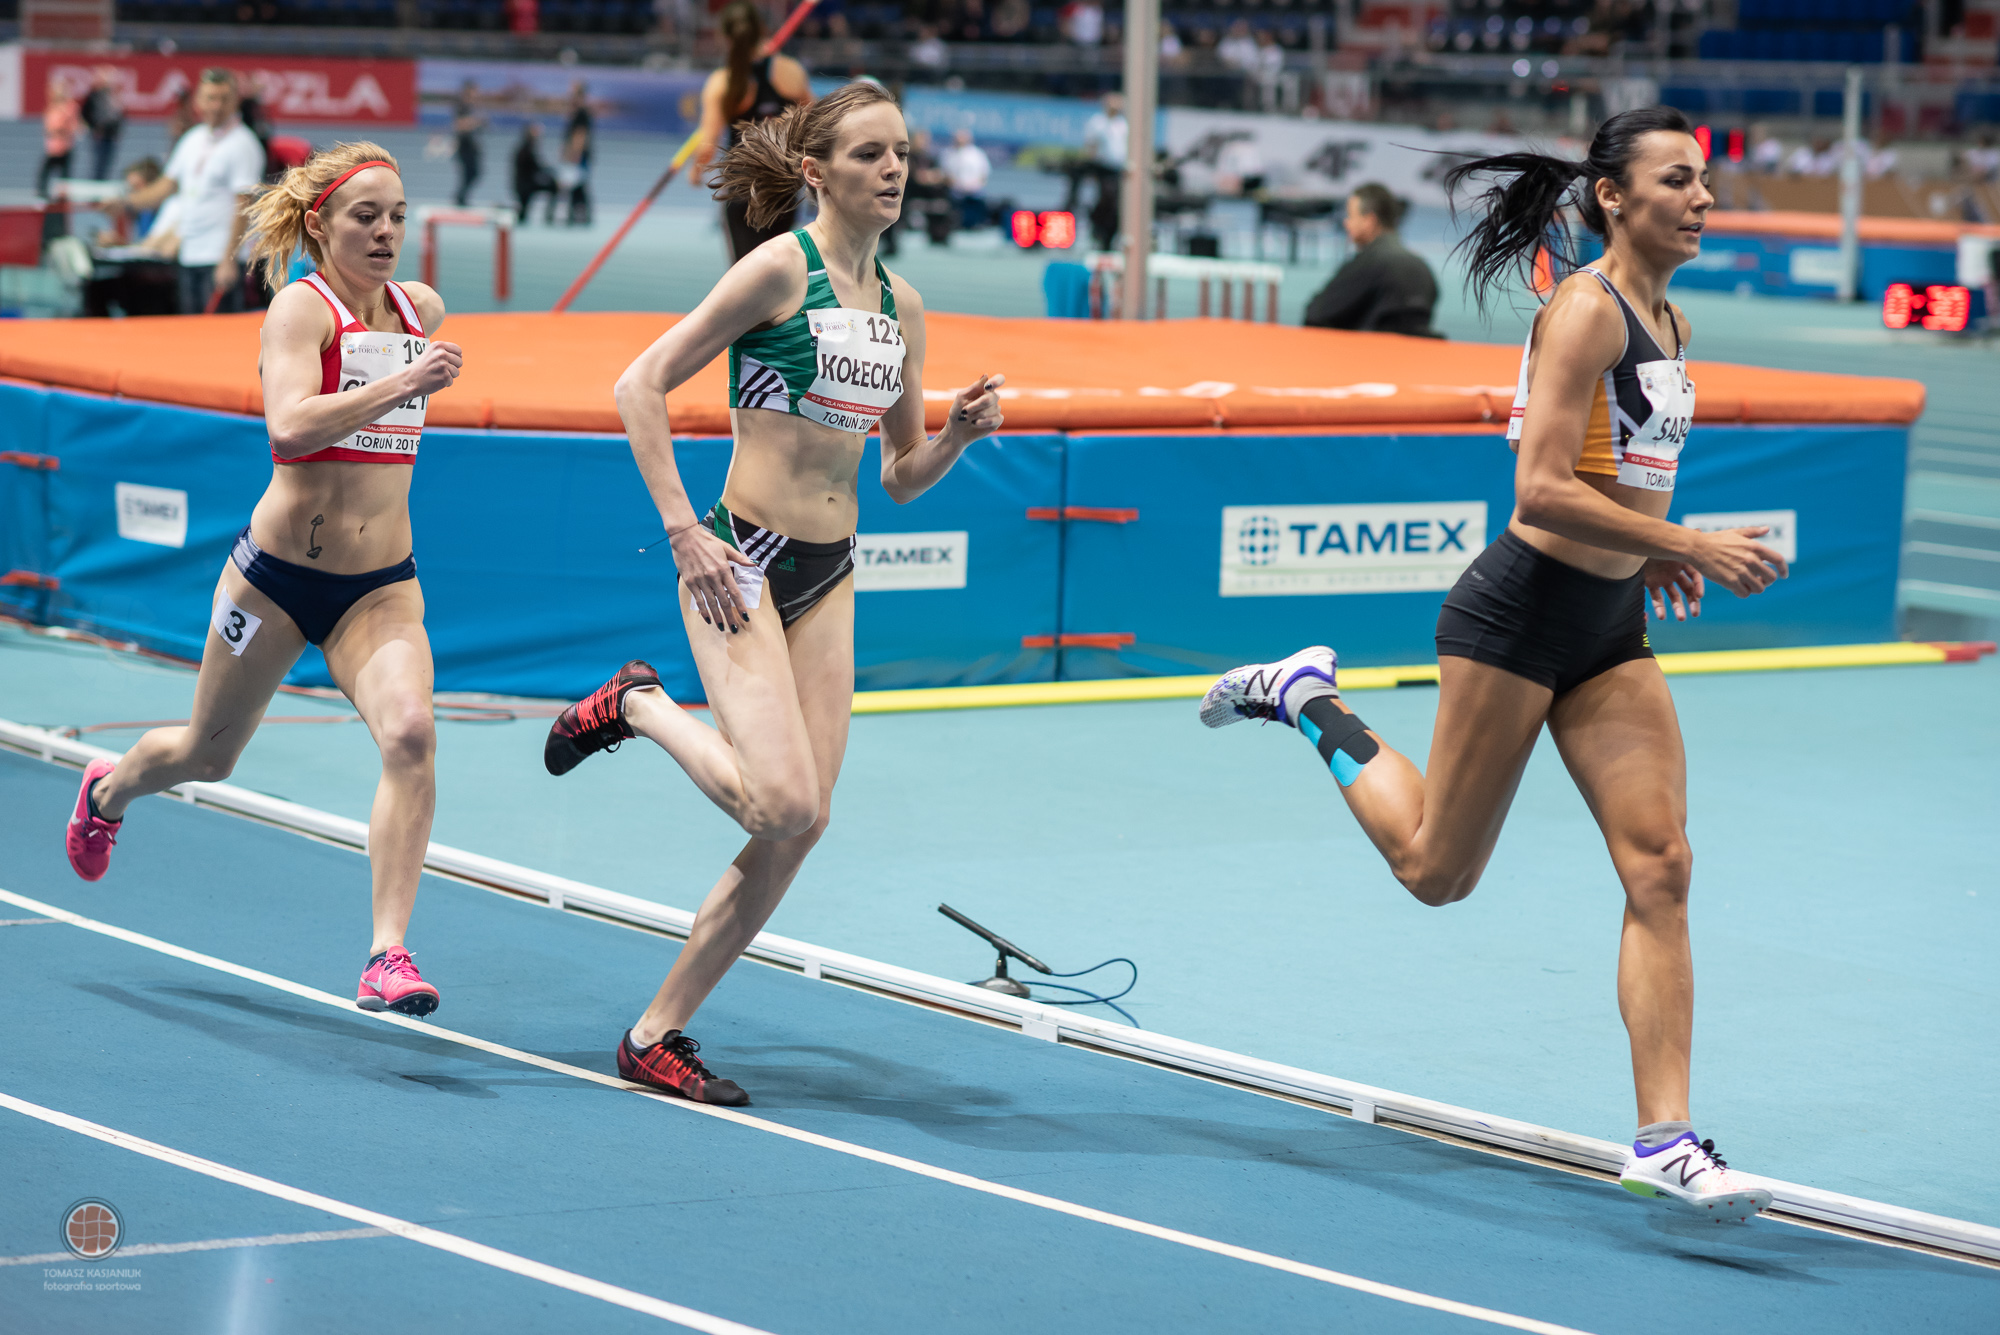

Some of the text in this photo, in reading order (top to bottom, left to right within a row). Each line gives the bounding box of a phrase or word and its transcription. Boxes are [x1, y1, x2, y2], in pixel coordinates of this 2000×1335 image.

[821, 353, 902, 393] KOŁECKA
[822, 411, 859, 430] TORUŃ
[355, 434, 393, 450] TORUŃ
[1288, 519, 1468, 556] TAMEX
[861, 547, 953, 566] TAMEX
[224, 610, 247, 643] 3
